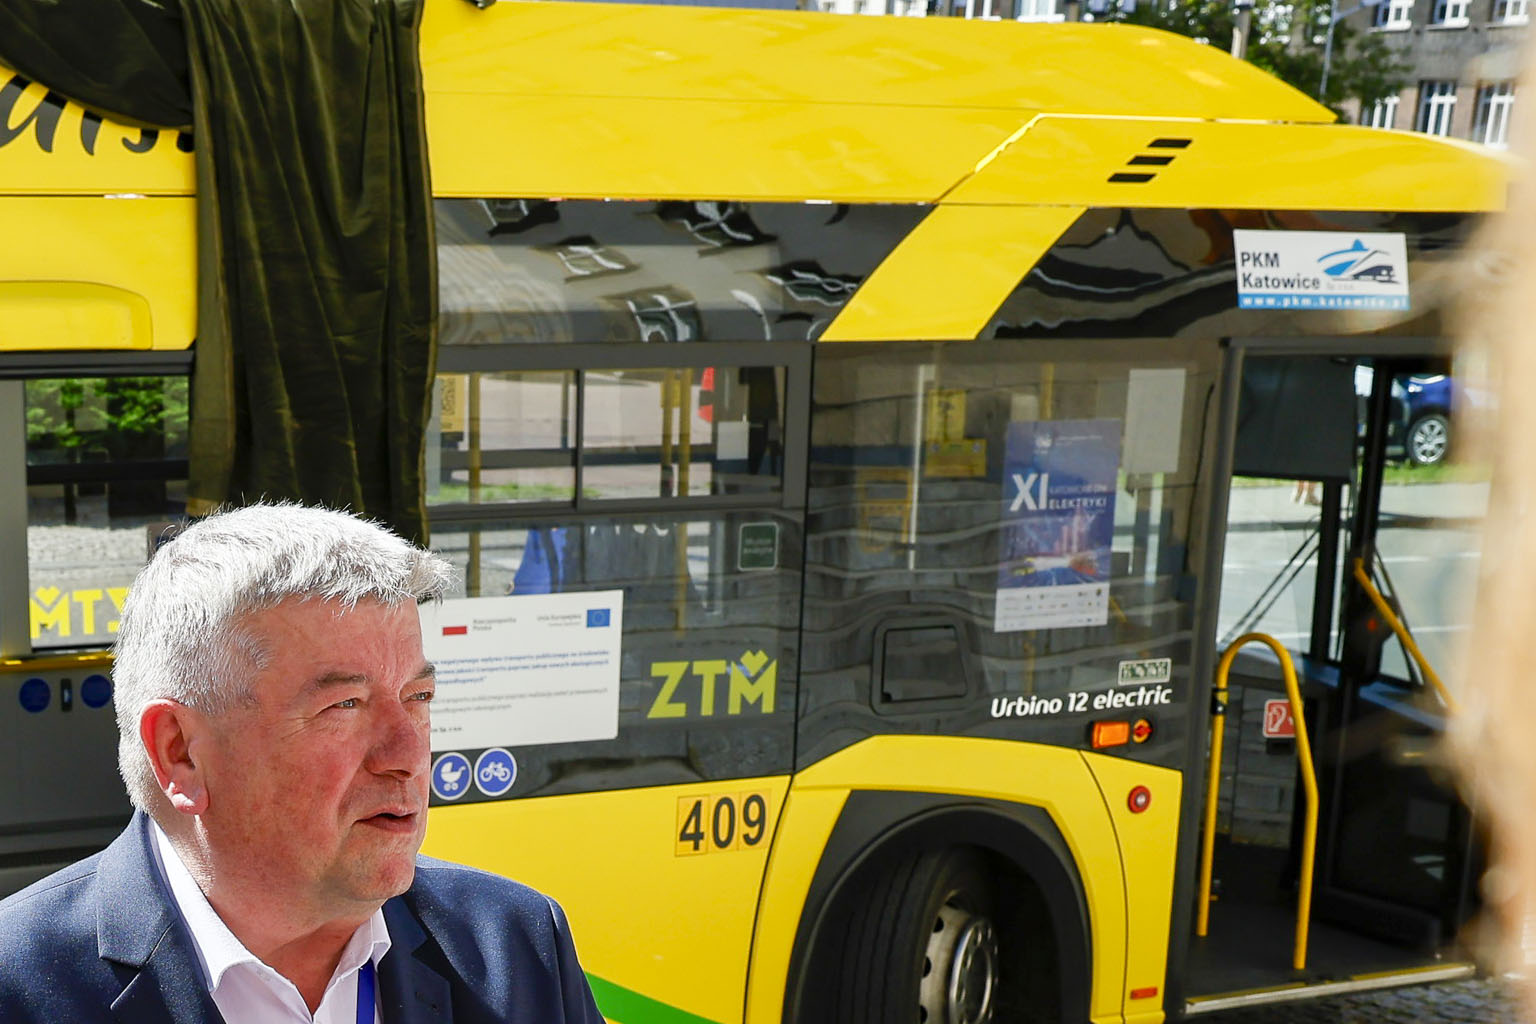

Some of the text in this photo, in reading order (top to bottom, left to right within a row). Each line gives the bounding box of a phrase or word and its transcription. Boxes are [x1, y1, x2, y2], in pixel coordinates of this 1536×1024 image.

[1240, 251, 1280, 268] PKM
[1242, 272, 1321, 290] Katowice
[1009, 473, 1049, 512] XI
[647, 653, 778, 718] ZTM
[991, 685, 1173, 718] Urbino 12 electric
[679, 794, 767, 851] 409
